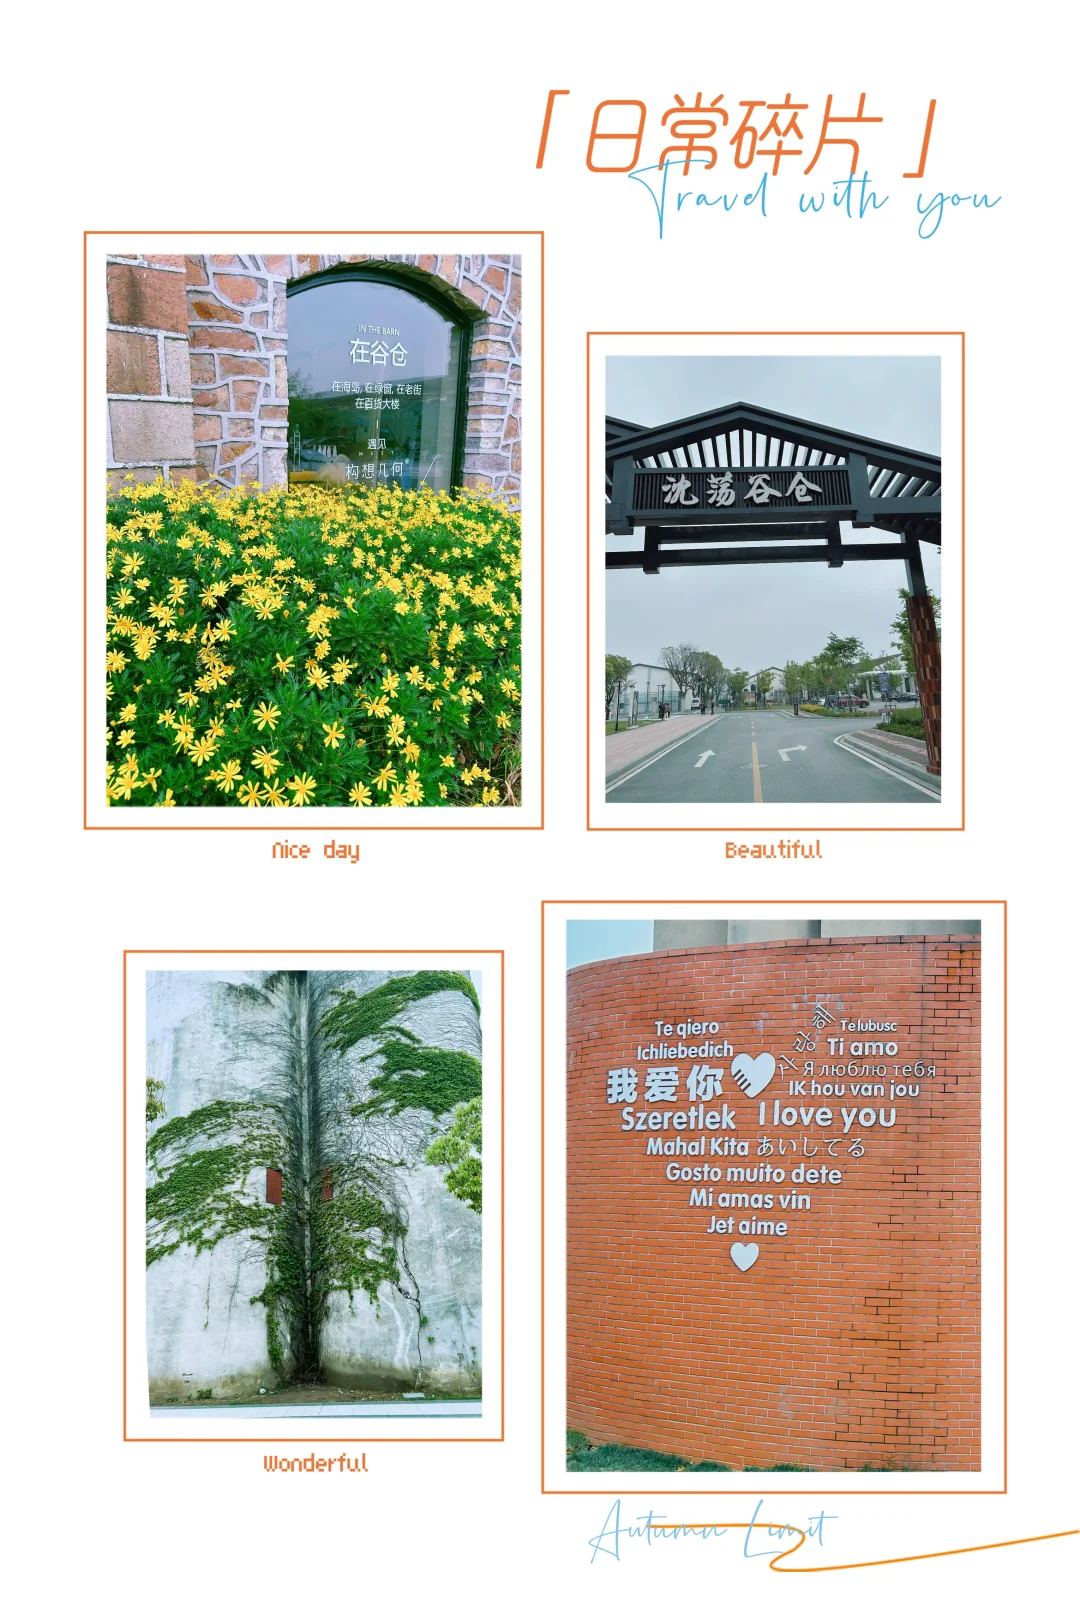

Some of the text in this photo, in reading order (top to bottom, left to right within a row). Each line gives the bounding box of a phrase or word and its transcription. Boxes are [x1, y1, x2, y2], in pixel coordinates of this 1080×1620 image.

[358, 324, 400, 336] IN THE BARN
[350, 339, 408, 367] 在谷仓
[355, 397, 400, 410] 在百货大楼
[367, 438, 387, 450] 遇见
[661, 470, 823, 507] 沈荡谷仓
[655, 1018, 719, 1040] Te qiero
[637, 1039, 734, 1061] Ichliebedich
[826, 1037, 899, 1056] Ti amo
[803, 1060, 937, 1077] Я люблю тебя
[606, 1064, 725, 1104] 我爱你
[811, 1079, 846, 1097] hou
[850, 1083, 885, 1097] van
[889, 1079, 920, 1100] jou
[621, 1103, 737, 1131] Szeretlek
[758, 1099, 897, 1133] I love you
[646, 1135, 749, 1157] Mahal Kita
[756, 1135, 866, 1158] あいしてる
[665, 1162, 843, 1185] Gosto muito dete
[689, 1187, 812, 1211] Mi amas vin
[706, 1215, 789, 1237] Jet aime
